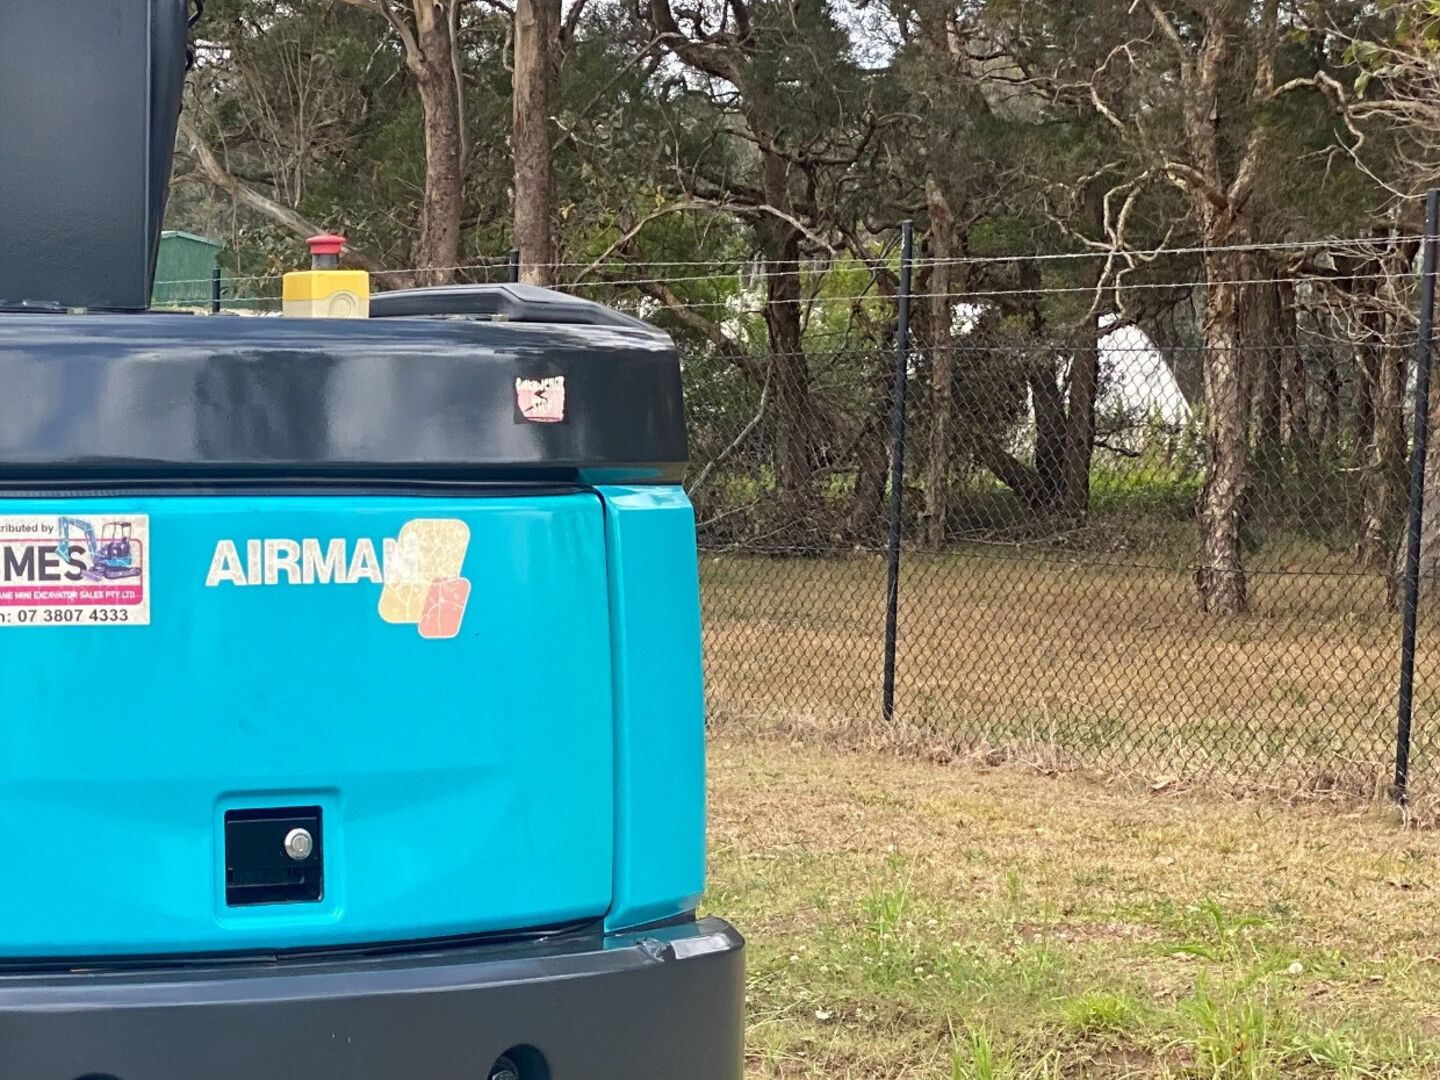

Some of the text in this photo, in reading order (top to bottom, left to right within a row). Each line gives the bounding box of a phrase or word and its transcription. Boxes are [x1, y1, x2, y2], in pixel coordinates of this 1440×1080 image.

[41, 523, 54, 534] by
[34, 591, 77, 600] EXCAVATOR
[80, 590, 104, 599] SALES
[105, 590, 120, 599] PTY
[121, 590, 136, 598] LTD
[18, 610, 36, 622] 07
[44, 609, 83, 622] 3807
[89, 609, 129, 621] 4333
